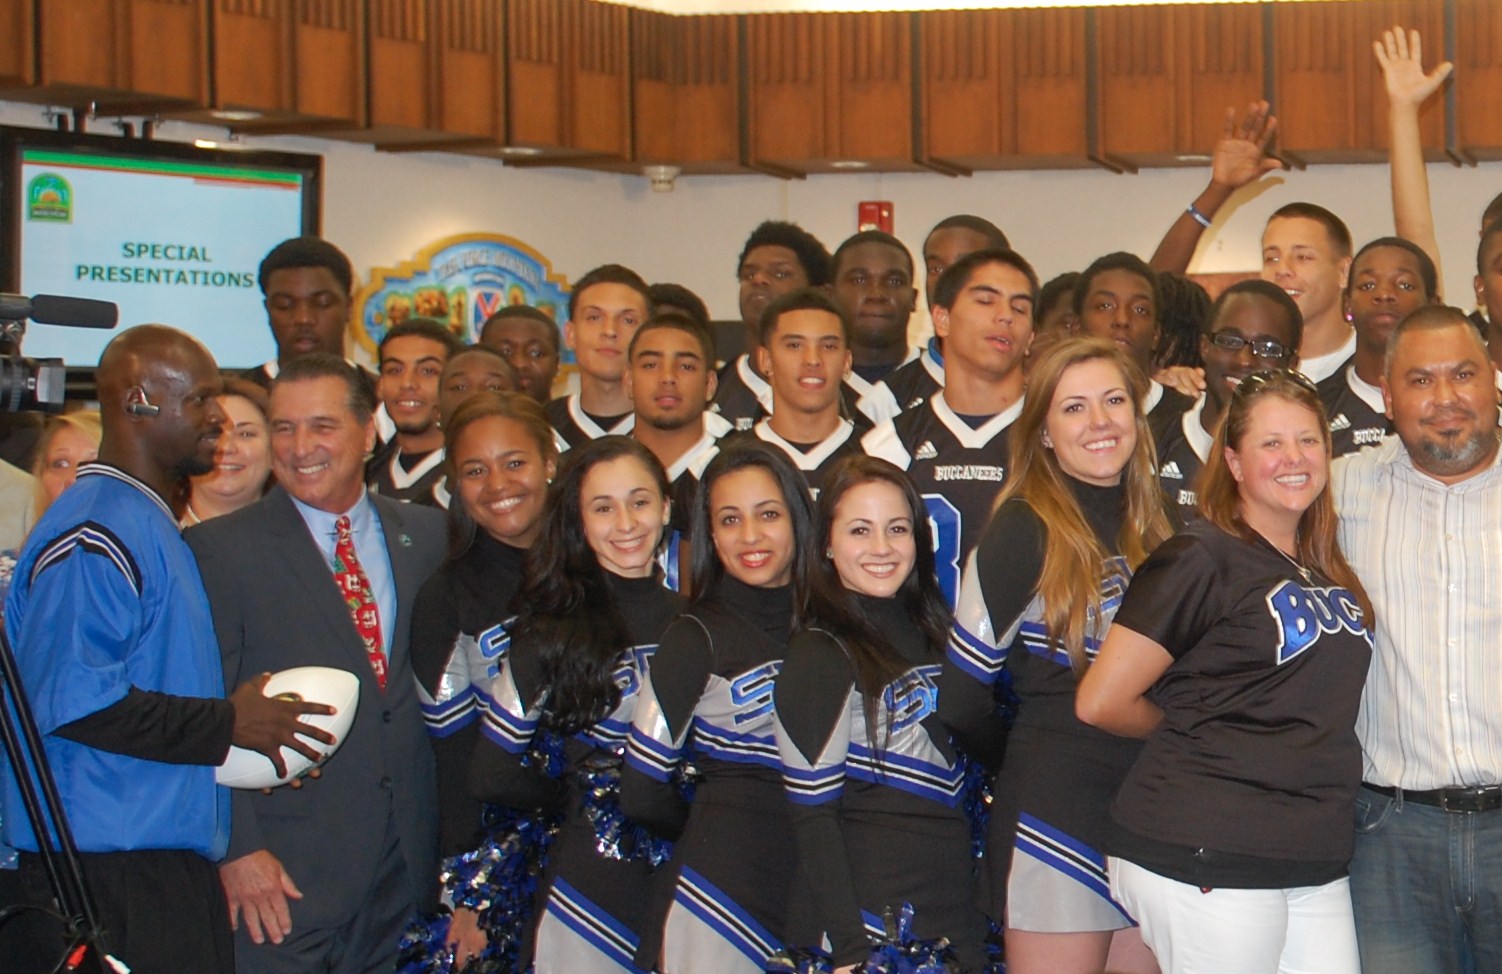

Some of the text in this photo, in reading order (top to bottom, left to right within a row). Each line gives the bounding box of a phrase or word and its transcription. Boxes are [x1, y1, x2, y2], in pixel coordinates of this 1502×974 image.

[121, 242, 212, 262] SPECIAL
[76, 264, 254, 288] PRESENTATIONS
[934, 465, 1003, 481] BUCCANEERS
[1265, 579, 1375, 666] BUC
